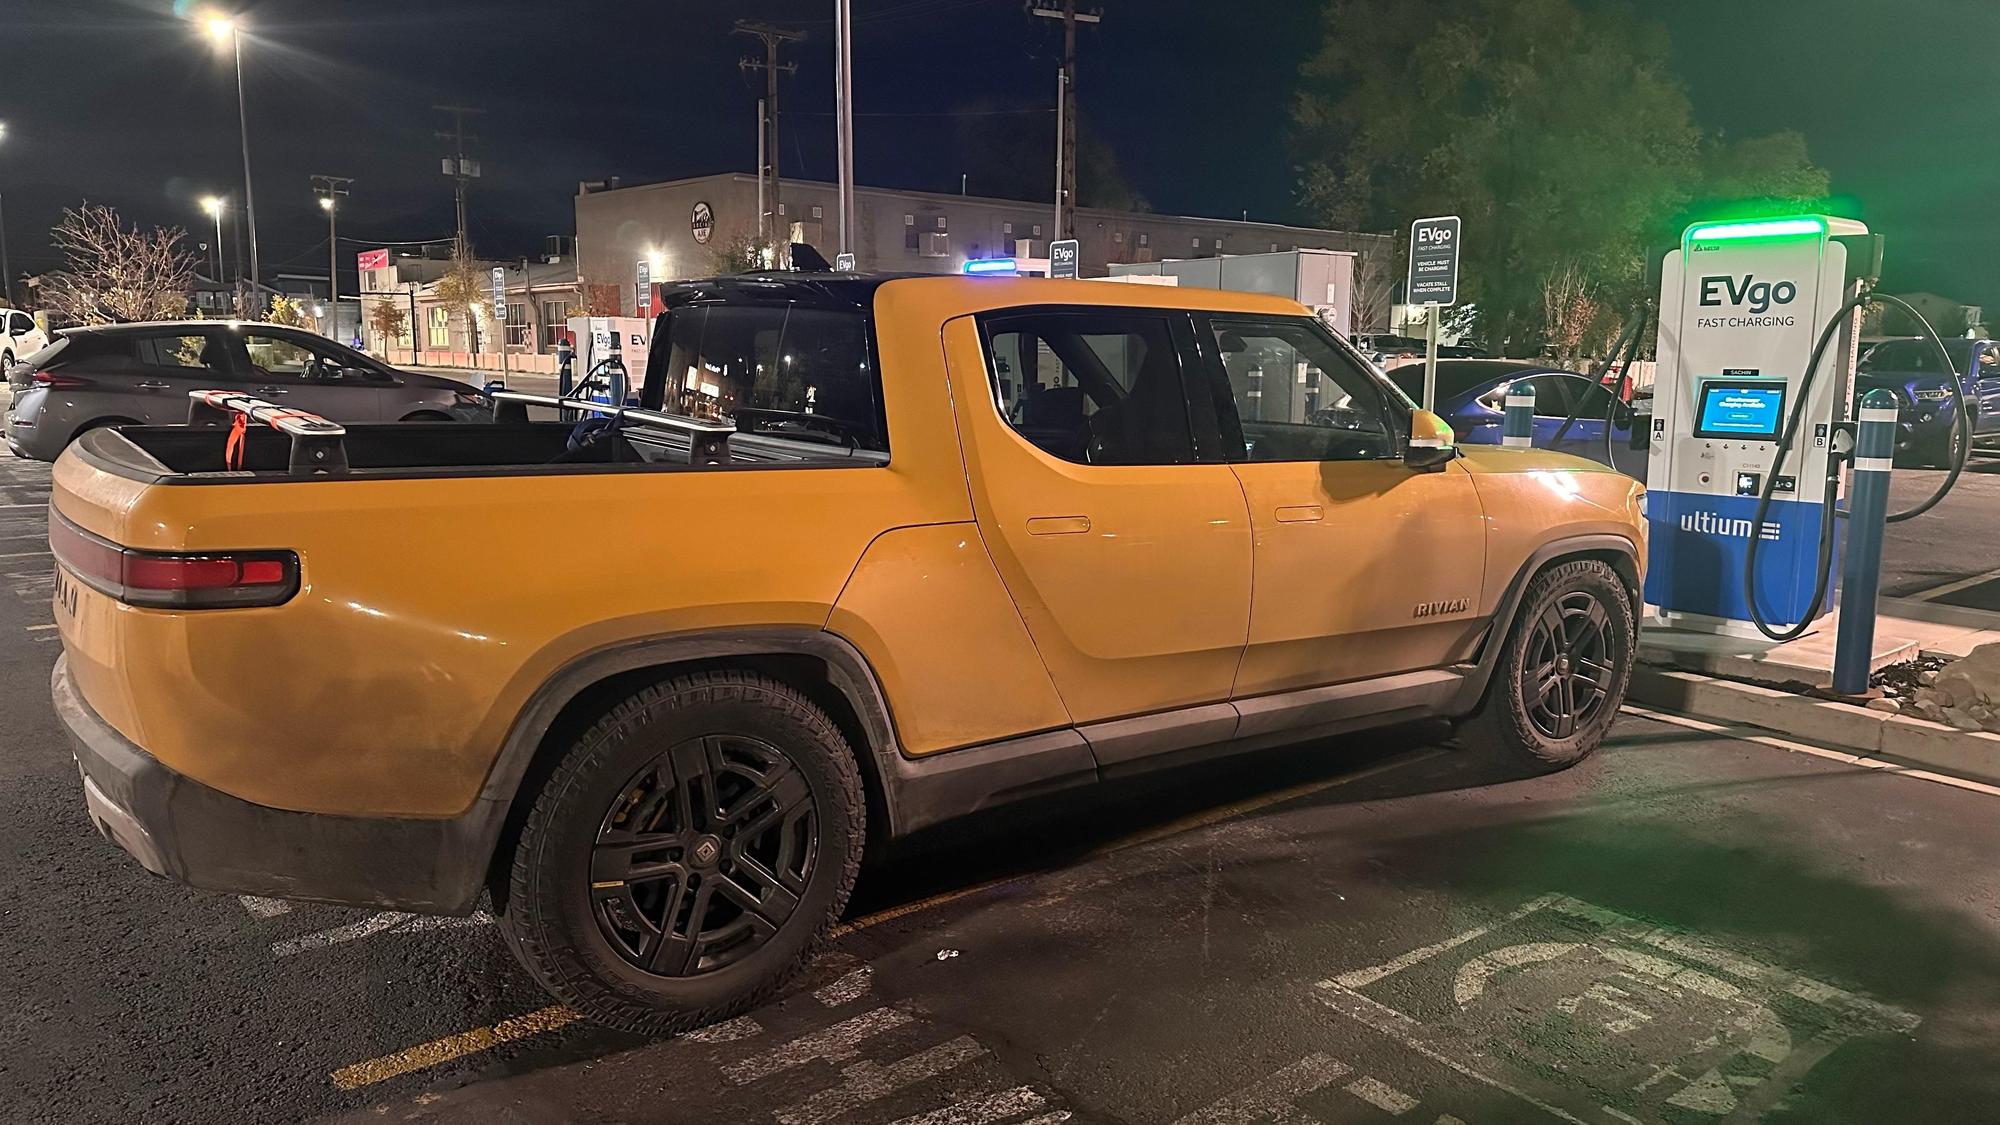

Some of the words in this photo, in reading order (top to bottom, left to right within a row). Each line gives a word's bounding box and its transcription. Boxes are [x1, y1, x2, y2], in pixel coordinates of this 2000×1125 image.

[1419, 227, 1452, 244] EVgo
[1054, 248, 1073, 261] EVgo
[1700, 274, 1797, 314] EVgo
[1698, 318, 1726, 328] FAST
[1728, 316, 1795, 328] CHARGING
[1655, 432, 1662, 440] A
[1817, 438, 1824, 446] B
[1681, 511, 1752, 537] ultium
[1415, 598, 1470, 616] RIVIAN
